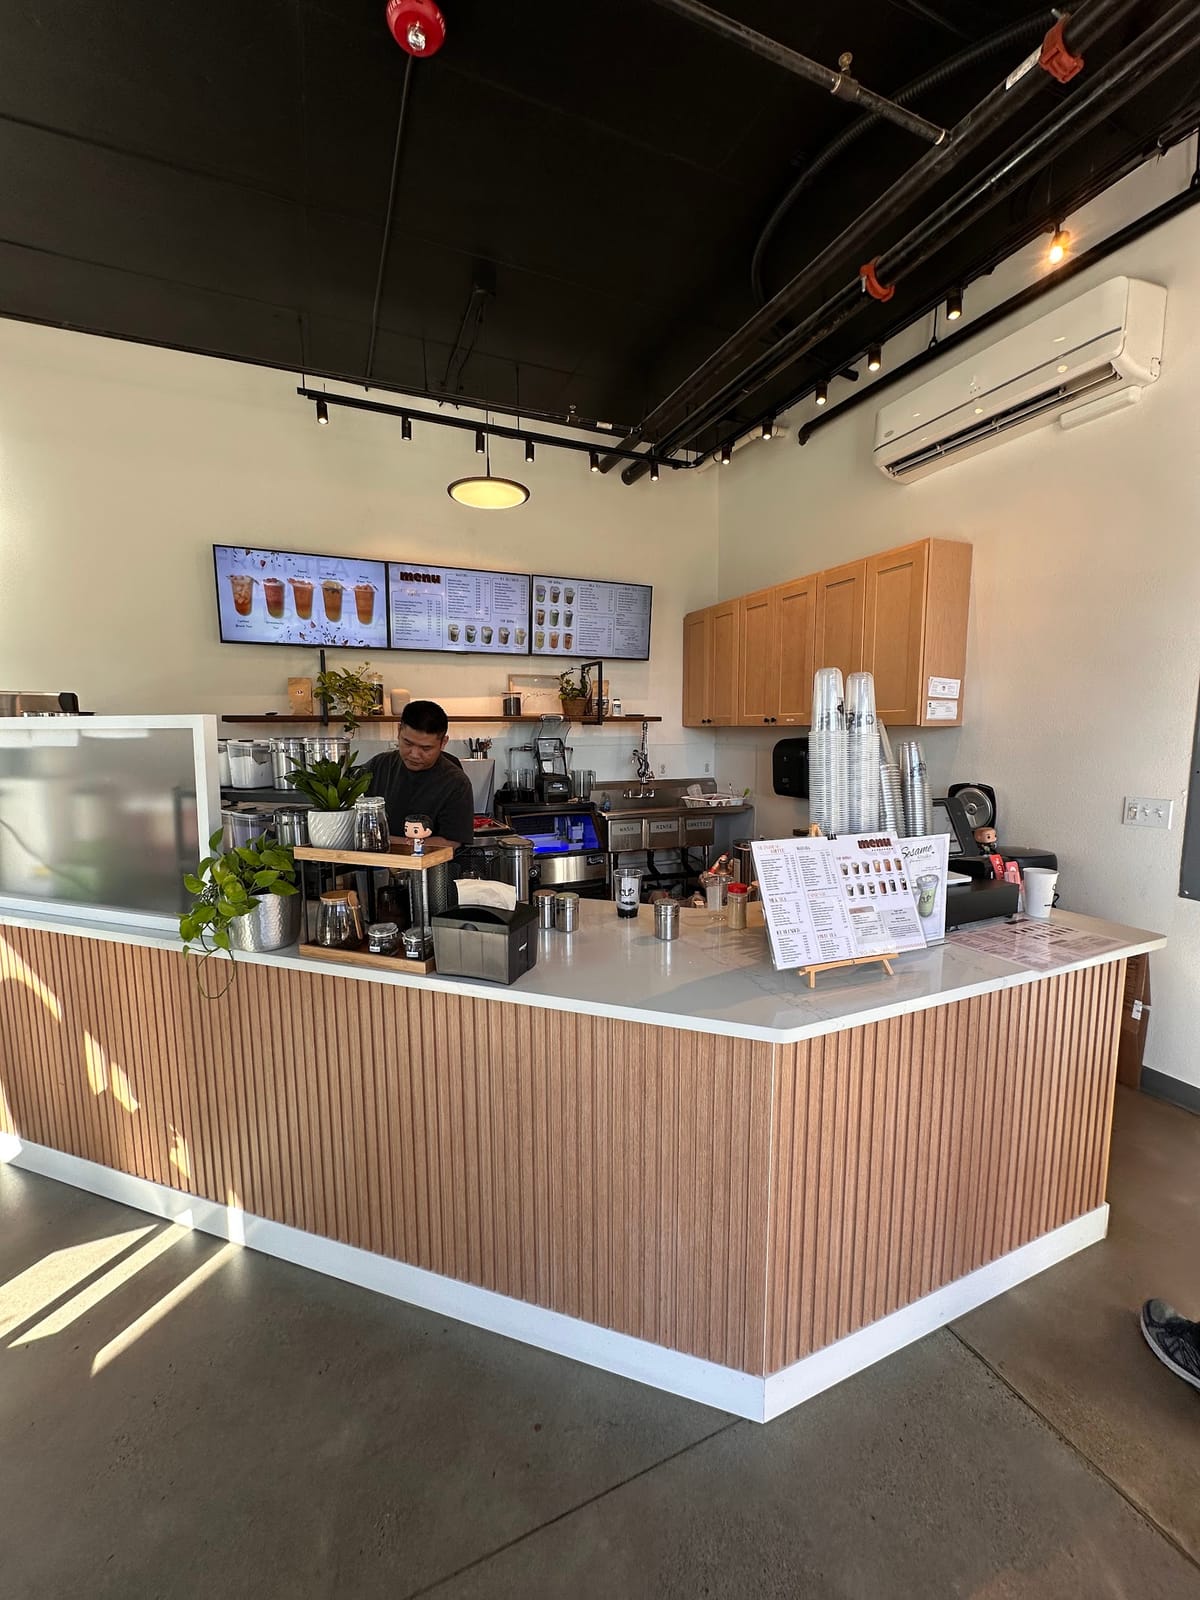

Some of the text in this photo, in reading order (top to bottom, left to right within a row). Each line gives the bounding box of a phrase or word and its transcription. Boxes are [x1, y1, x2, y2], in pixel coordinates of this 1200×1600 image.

[400, 571, 441, 585] menu
[857, 838, 892, 849] menu
[901, 844, 932, 859] Sesame
